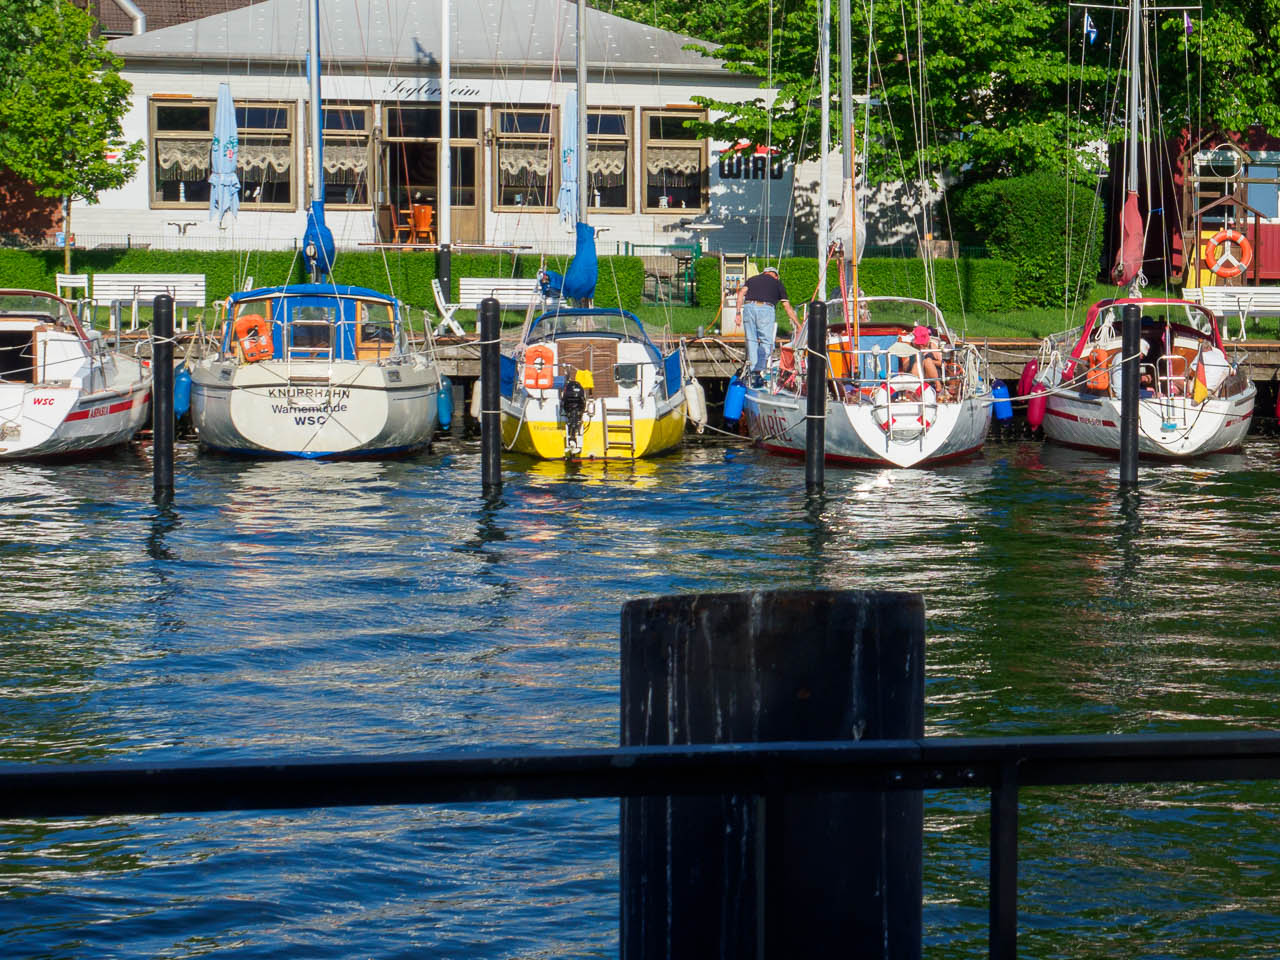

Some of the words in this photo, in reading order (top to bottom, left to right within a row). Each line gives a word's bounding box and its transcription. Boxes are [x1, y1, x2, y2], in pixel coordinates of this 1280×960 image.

[383, 80, 480, 99] Seglereim
[269, 388, 350, 399] KNURRHAHN
[294, 416, 327, 426] WSC
